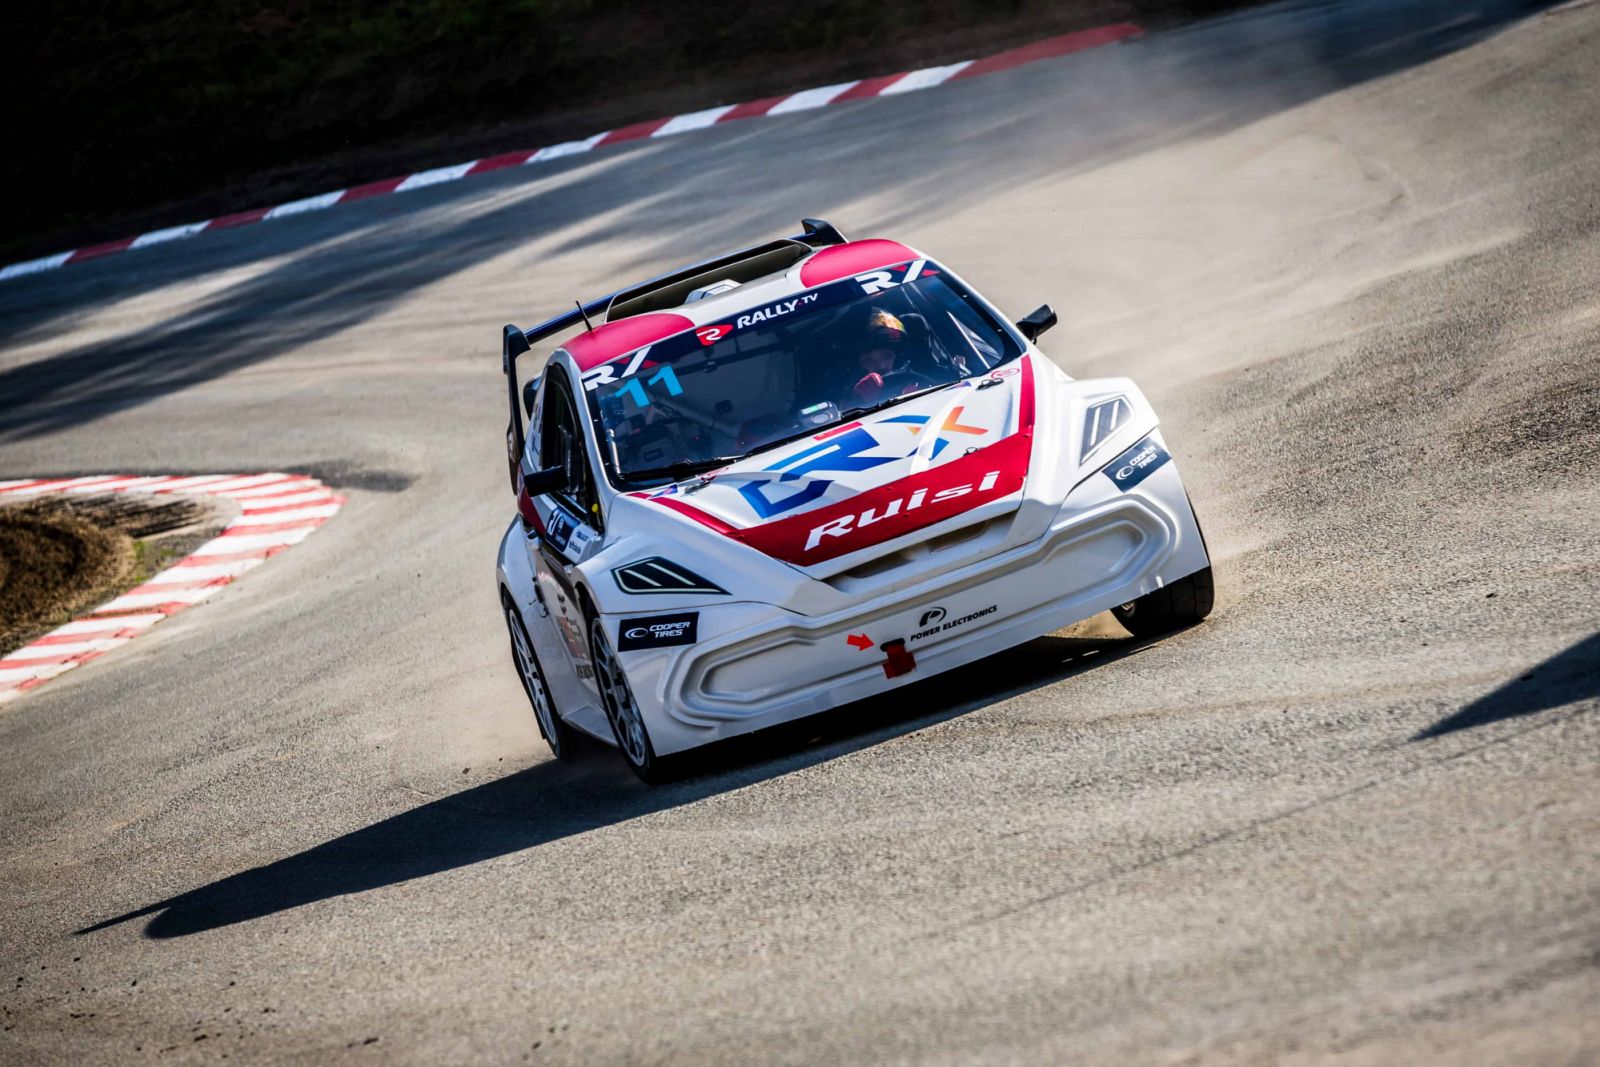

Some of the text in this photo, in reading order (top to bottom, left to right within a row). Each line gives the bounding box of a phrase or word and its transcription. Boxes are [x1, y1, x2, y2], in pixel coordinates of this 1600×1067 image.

[615, 364, 684, 408] 11
[649, 621, 691, 632] COOPER
[654, 629, 683, 638] TIRES
[910, 605, 998, 642] POWER ELECTRONICS
